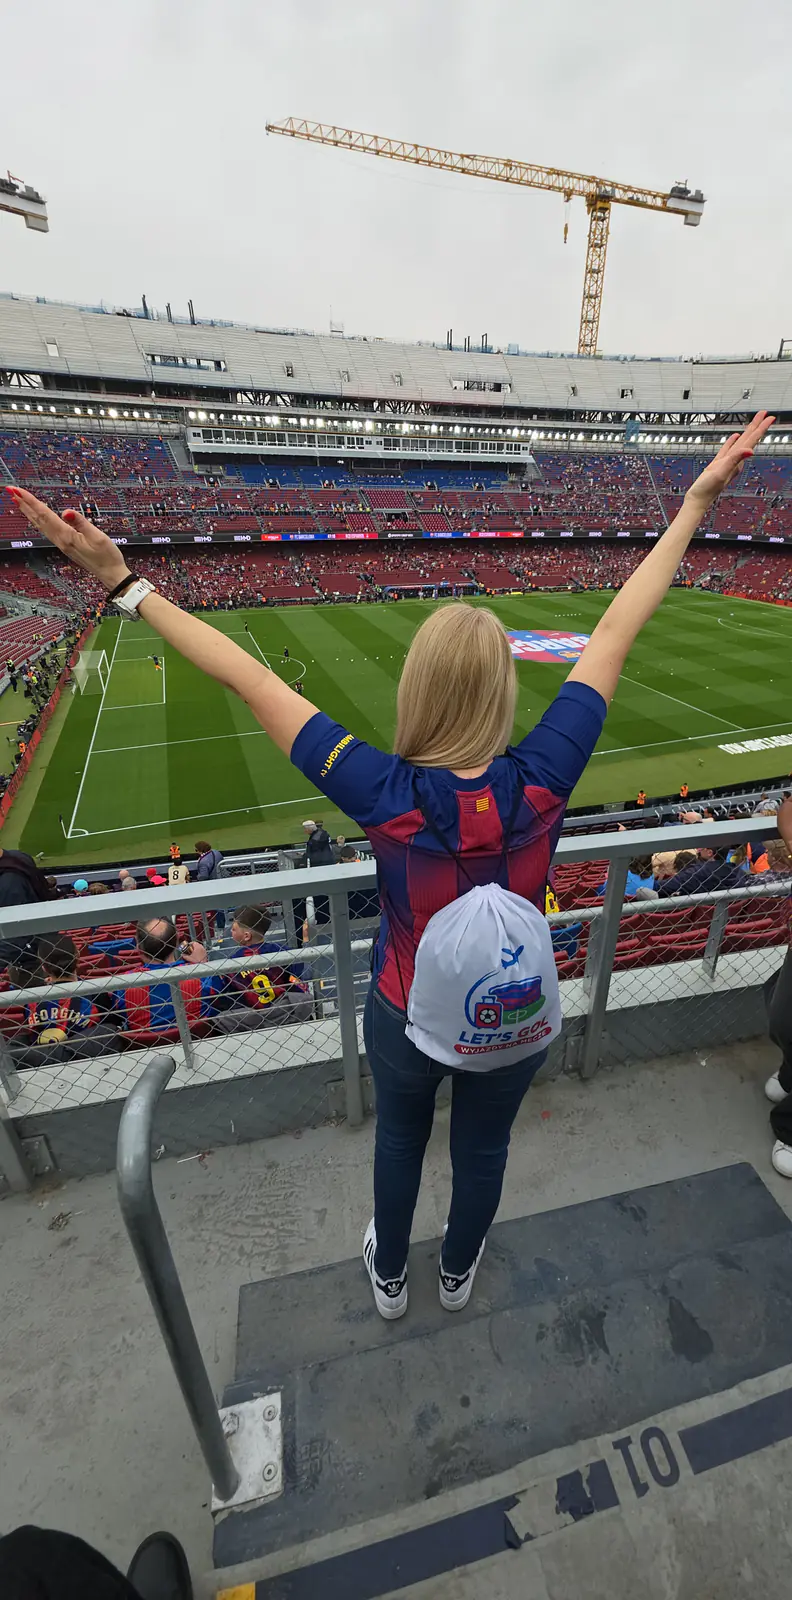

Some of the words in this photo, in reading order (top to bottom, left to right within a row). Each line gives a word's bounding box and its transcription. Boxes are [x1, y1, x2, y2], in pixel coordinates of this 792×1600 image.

[172, 869, 180, 881] 8
[252, 974, 276, 1004] 9
[28, 1007, 90, 1028] GEORGINA
[458, 1031, 513, 1045] LET'S
[517, 1015, 549, 1038] GOL
[460, 1044, 503, 1054] WYJAZDY
[505, 1041, 518, 1049] NA
[612, 1426, 680, 1499] 01
